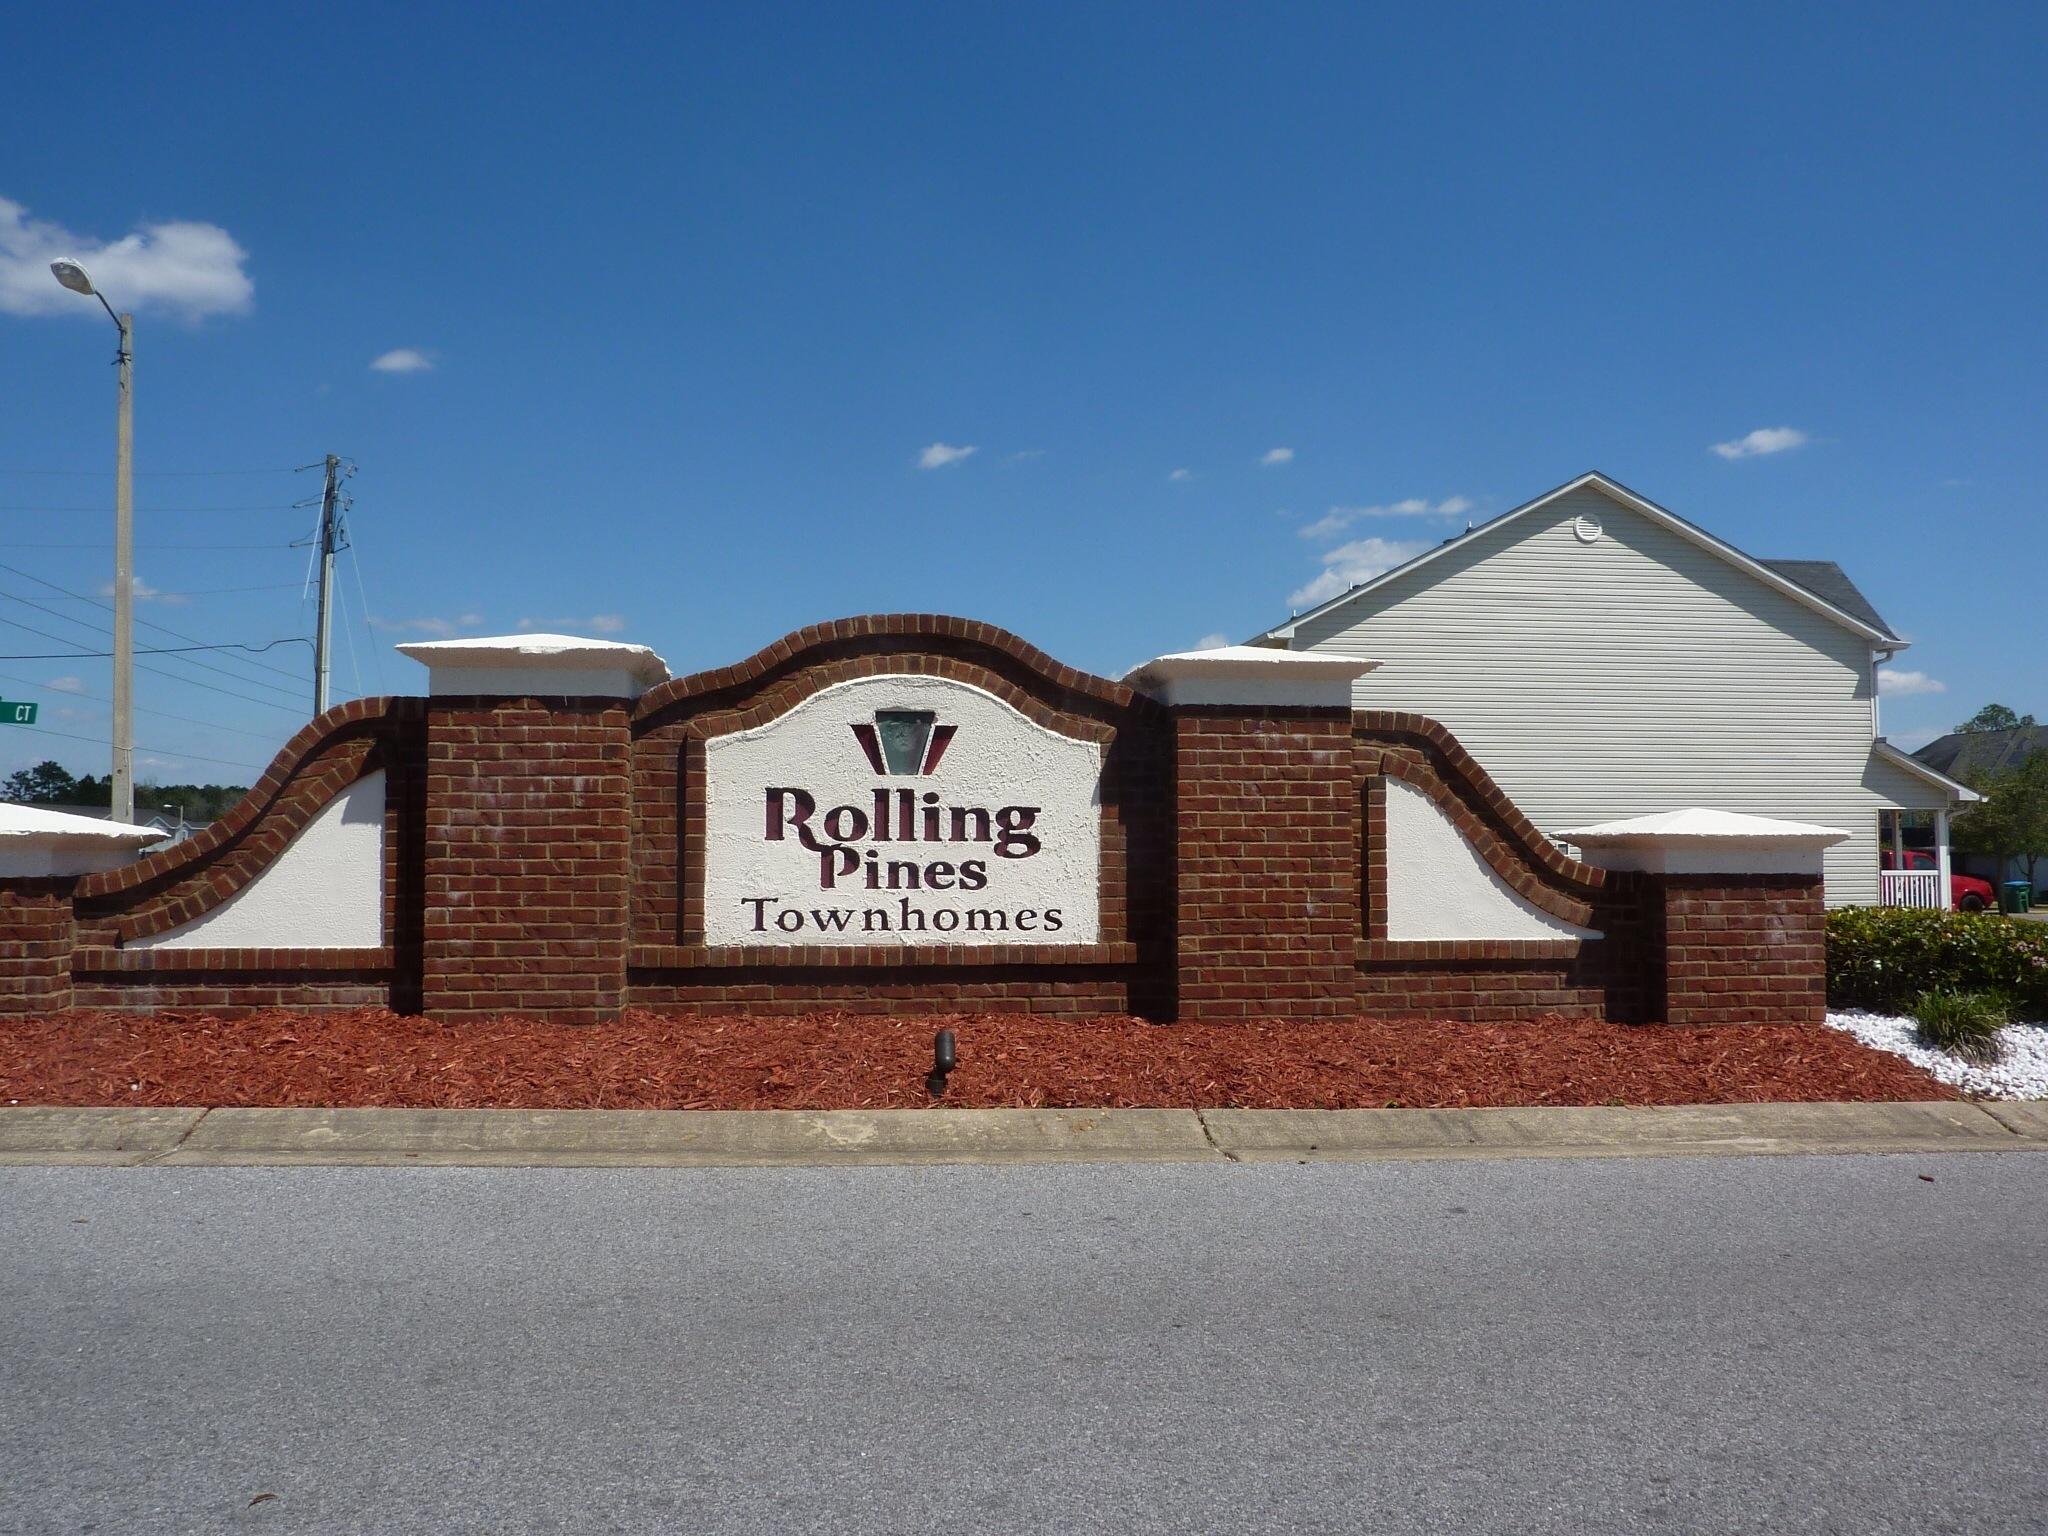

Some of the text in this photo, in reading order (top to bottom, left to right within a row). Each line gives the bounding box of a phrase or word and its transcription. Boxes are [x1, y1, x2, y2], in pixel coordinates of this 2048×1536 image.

[15, 705, 32, 721] CT
[764, 787, 1042, 859] Rolling
[820, 843, 988, 890] Pines
[741, 896, 1064, 932] Townhomes
